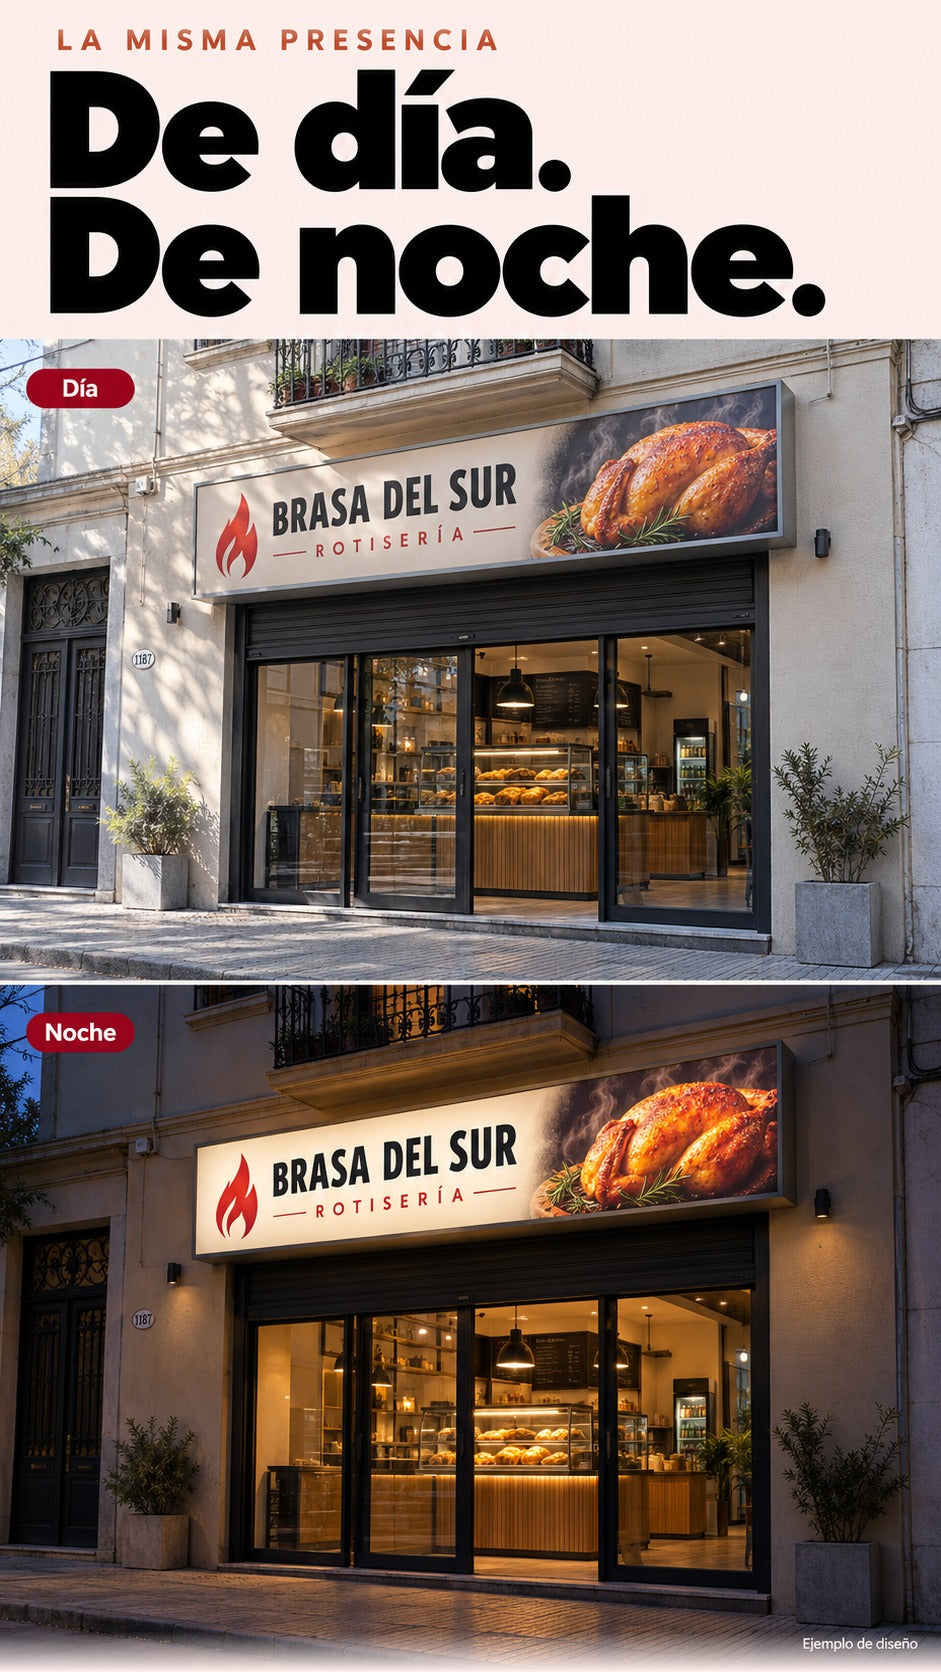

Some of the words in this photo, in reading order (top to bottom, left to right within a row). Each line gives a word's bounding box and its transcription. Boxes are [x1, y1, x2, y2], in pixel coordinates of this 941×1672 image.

[273, 485, 370, 536] BRASA
[383, 474, 438, 520] DEL
[449, 463, 517, 511] SUR
[315, 525, 463, 557] ROTISERÍA
[273, 1146, 370, 1197] BRASA
[383, 1135, 438, 1181] DEL
[449, 1124, 517, 1172] SUR
[315, 1185, 463, 1218] ROTISERÍA
